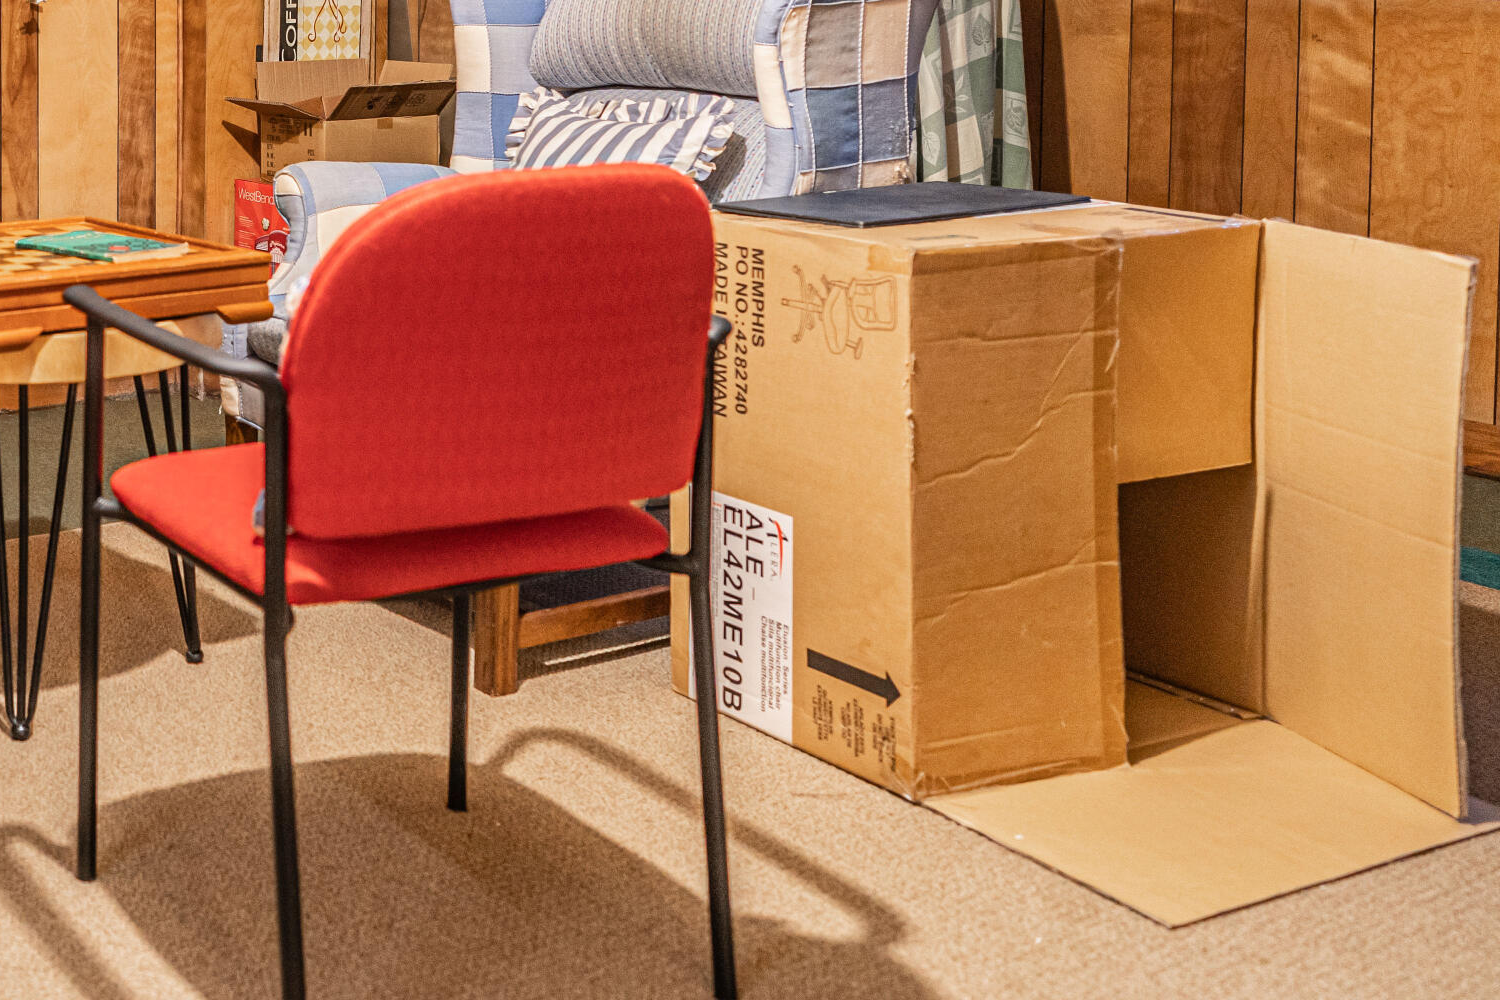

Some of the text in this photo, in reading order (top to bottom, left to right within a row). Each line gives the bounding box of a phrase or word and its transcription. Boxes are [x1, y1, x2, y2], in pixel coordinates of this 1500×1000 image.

[715, 242, 728, 304] MADE
[736, 246, 748, 275] PO
[752, 248, 765, 348] MEMPHIS
[722, 504, 743, 712] EL42ME10B
[767, 618, 775, 710] Silla multifuncional
